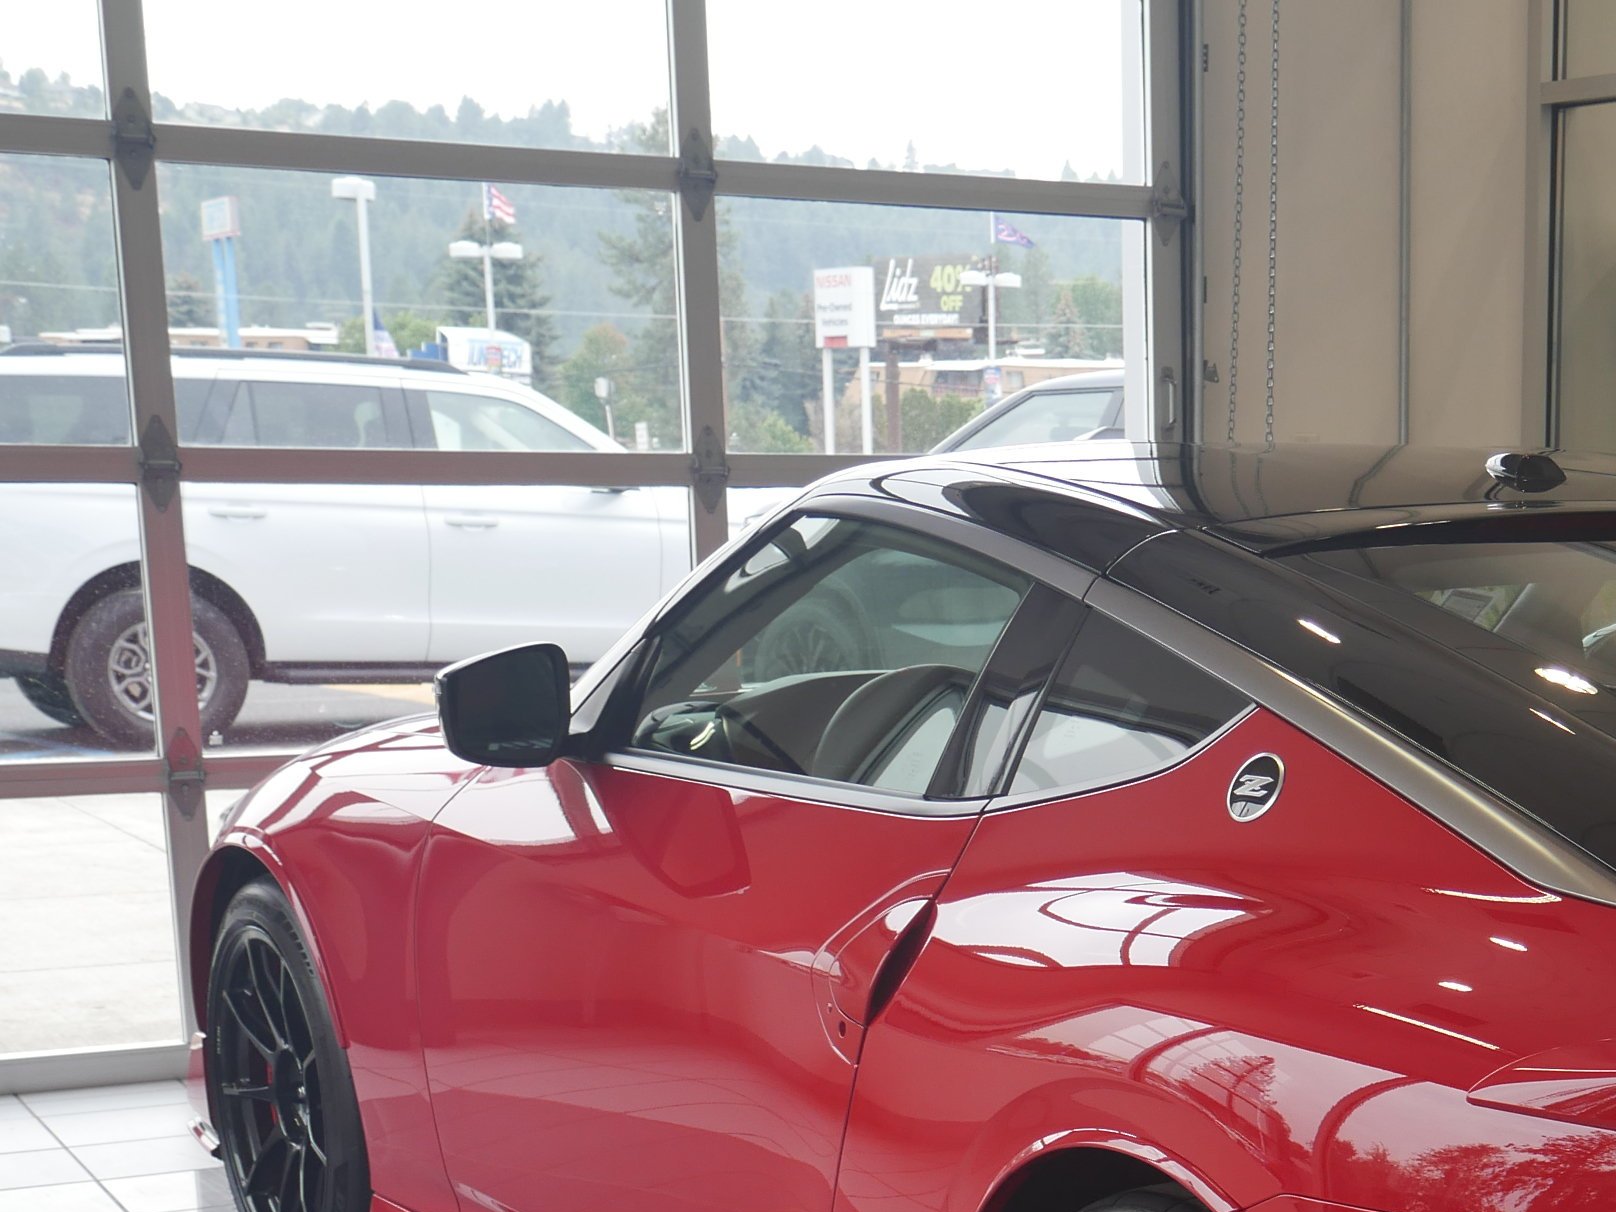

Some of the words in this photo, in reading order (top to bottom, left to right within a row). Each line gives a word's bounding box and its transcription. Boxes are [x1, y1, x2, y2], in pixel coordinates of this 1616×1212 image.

[815, 274, 852, 288] NISSAN
[880, 258, 919, 311] Lidz
[940, 294, 963, 312] OFF
